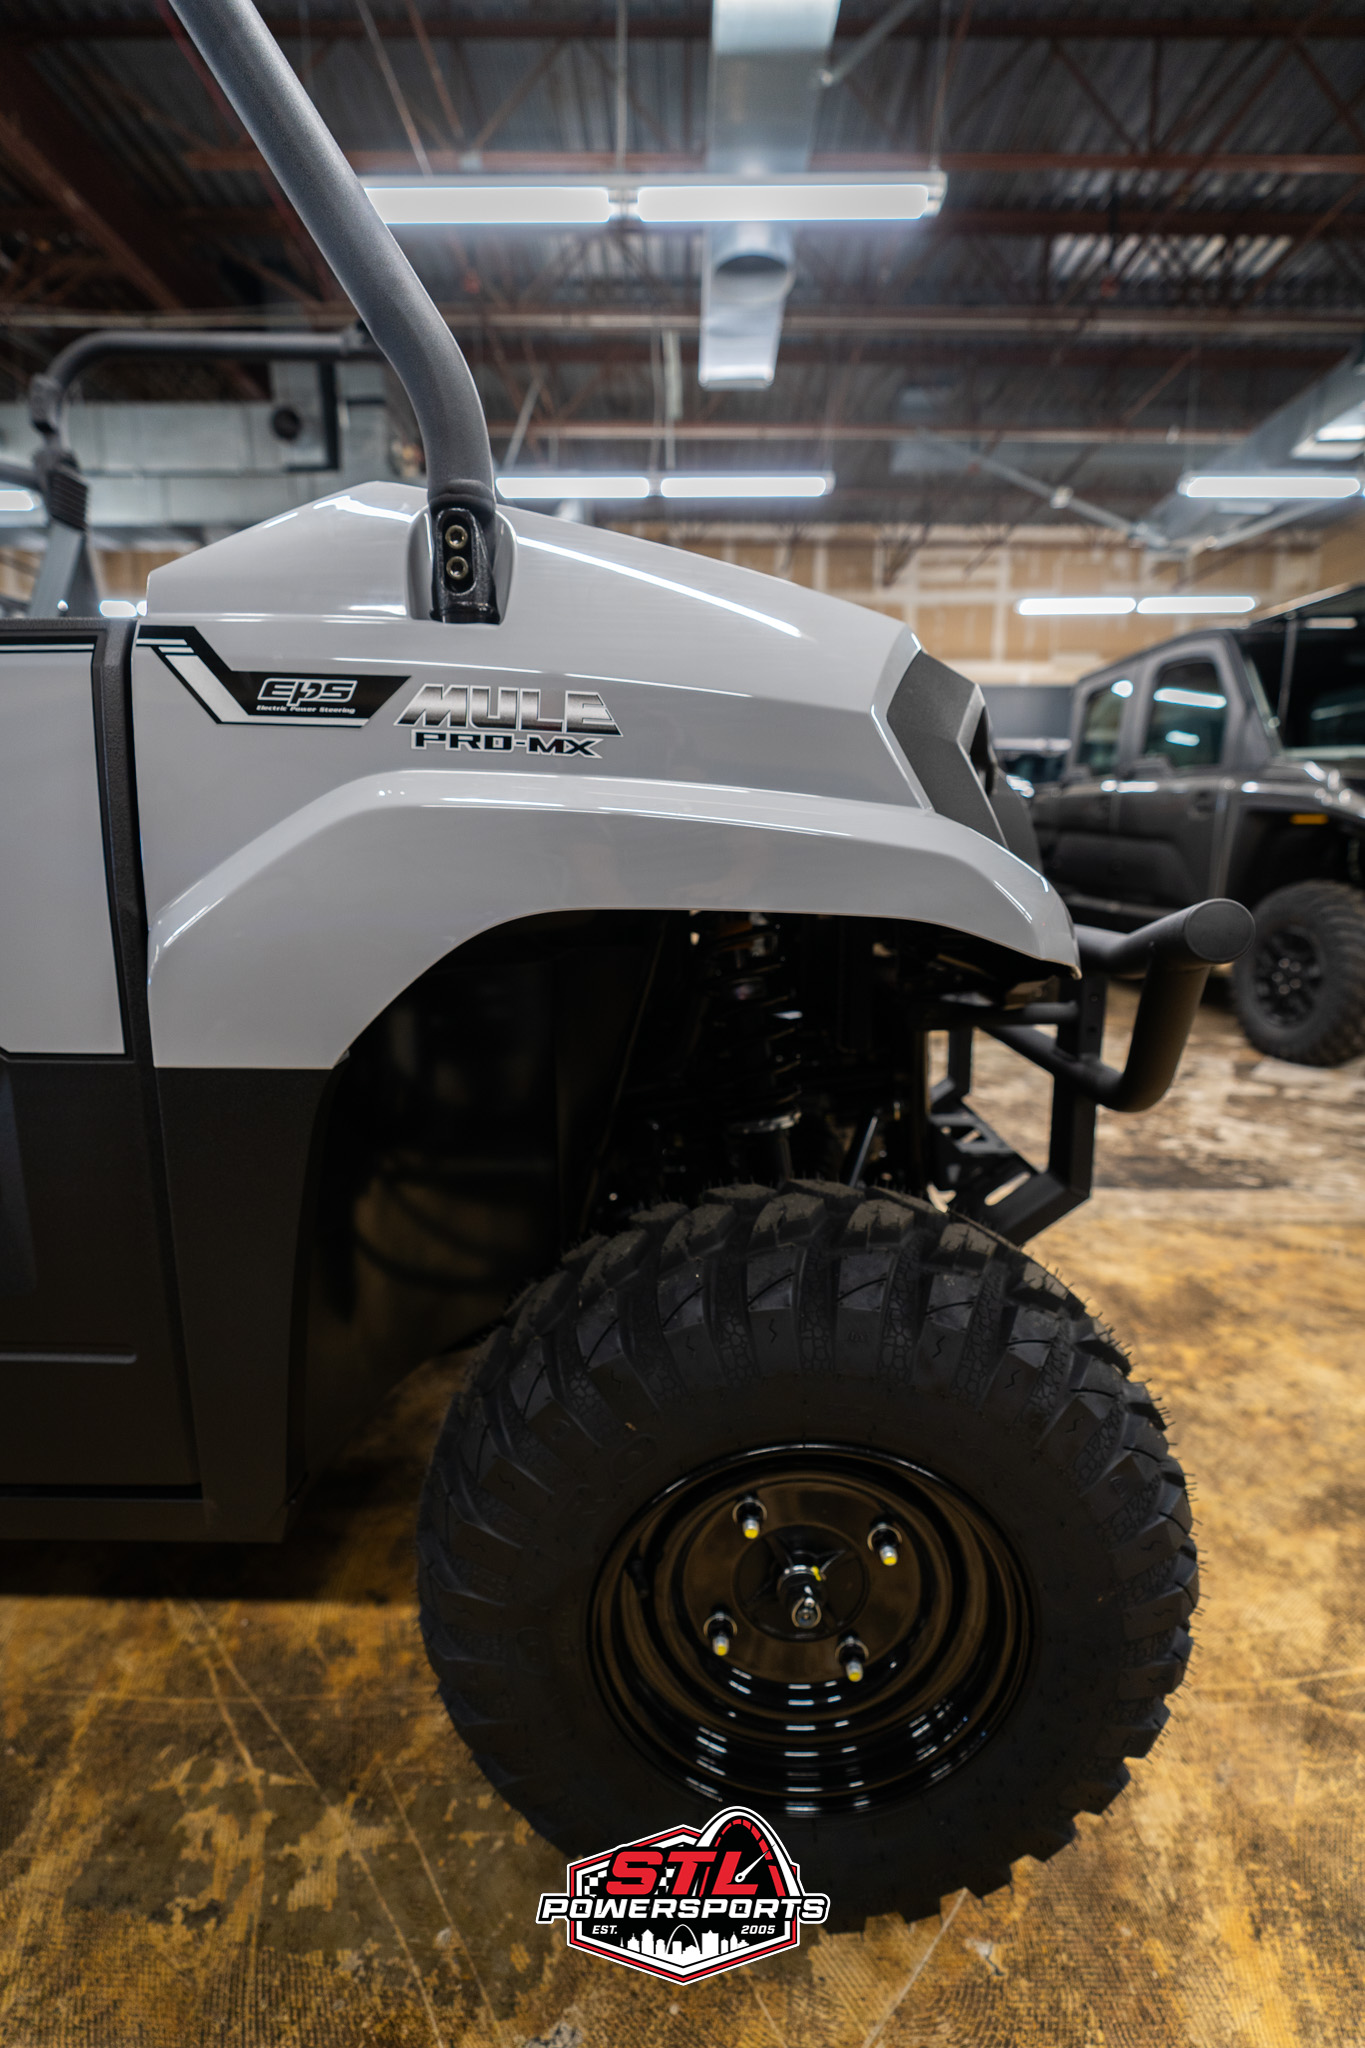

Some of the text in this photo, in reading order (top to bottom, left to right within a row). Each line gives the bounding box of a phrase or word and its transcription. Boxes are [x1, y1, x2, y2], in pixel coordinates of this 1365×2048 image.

[256, 704, 287, 712] Electric
[319, 706, 356, 715] Steering
[393, 683, 623, 737] MULE
[411, 729, 602, 759] PRO-MX
